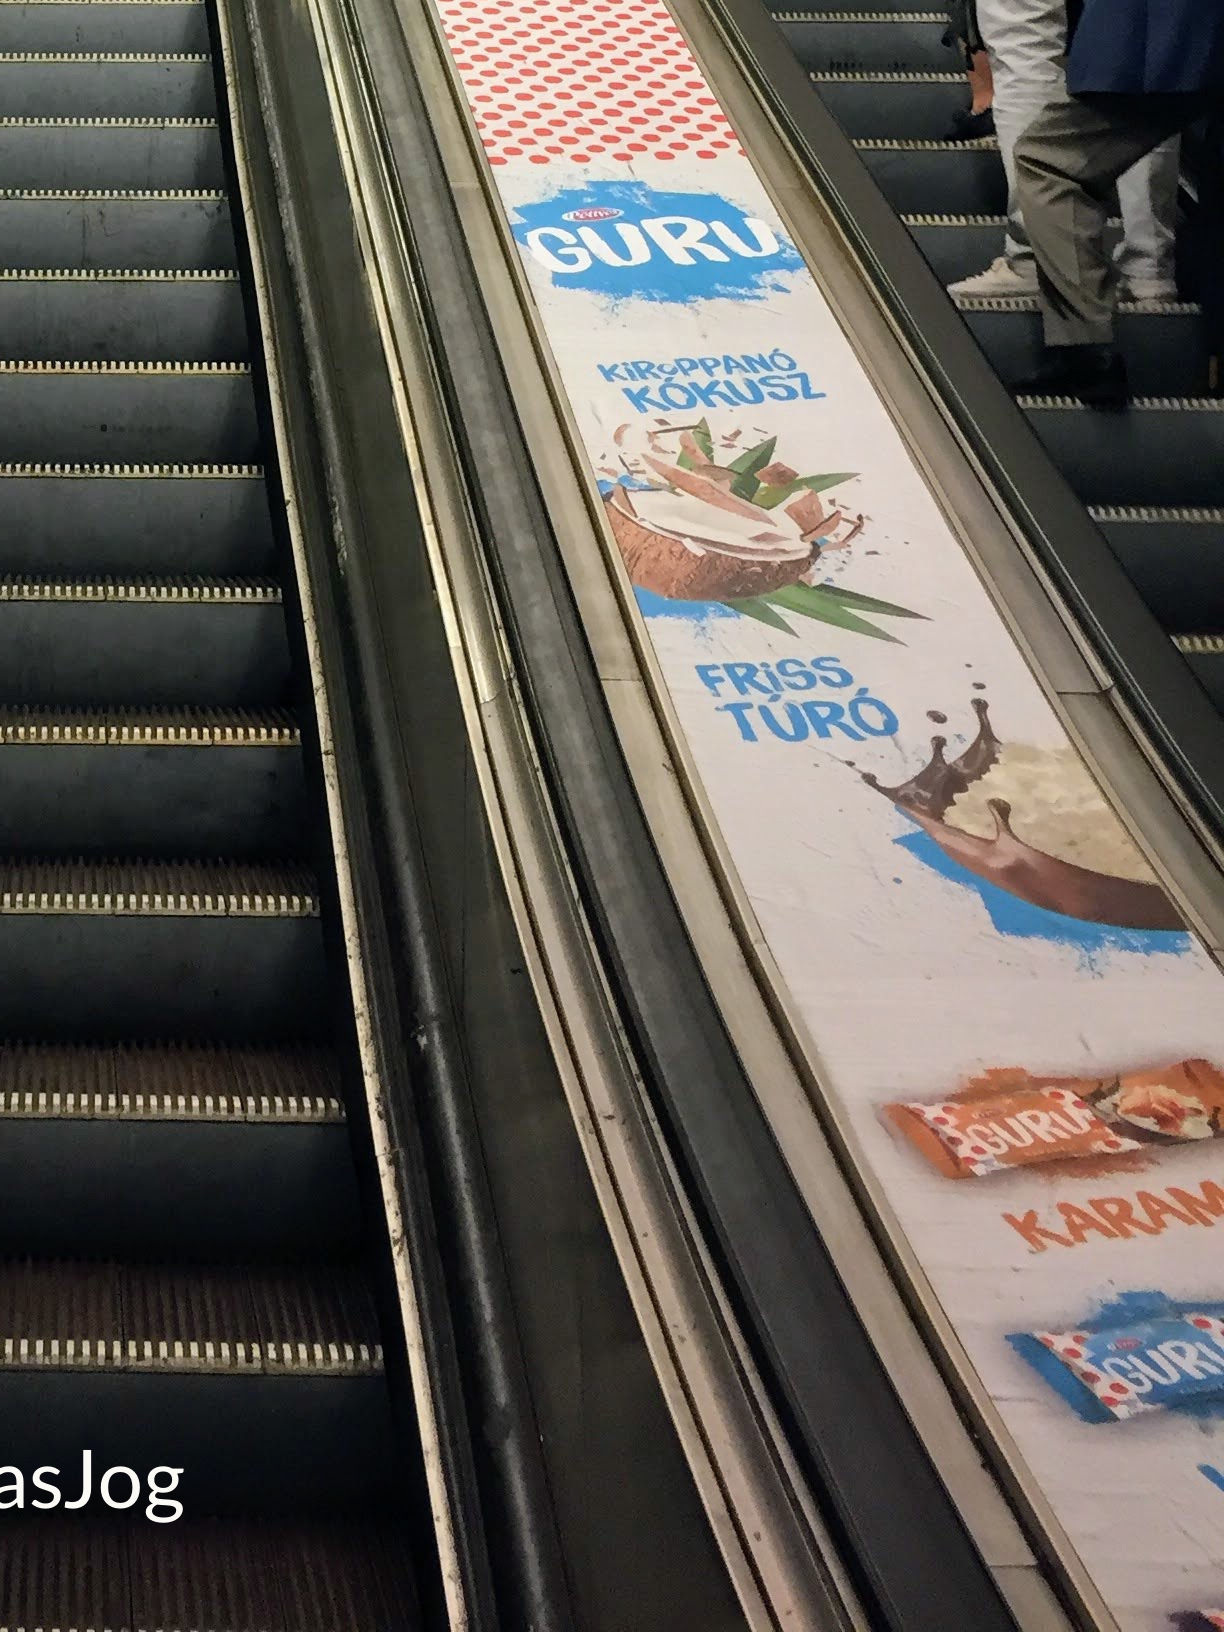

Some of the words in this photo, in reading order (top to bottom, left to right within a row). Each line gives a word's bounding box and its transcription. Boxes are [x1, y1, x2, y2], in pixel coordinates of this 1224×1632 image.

[524, 216, 780, 273] GURU
[621, 372, 827, 414] KÓKUSZ
[714, 686, 900, 742] TÚRÓ
[964, 1105, 1093, 1157] GURU
